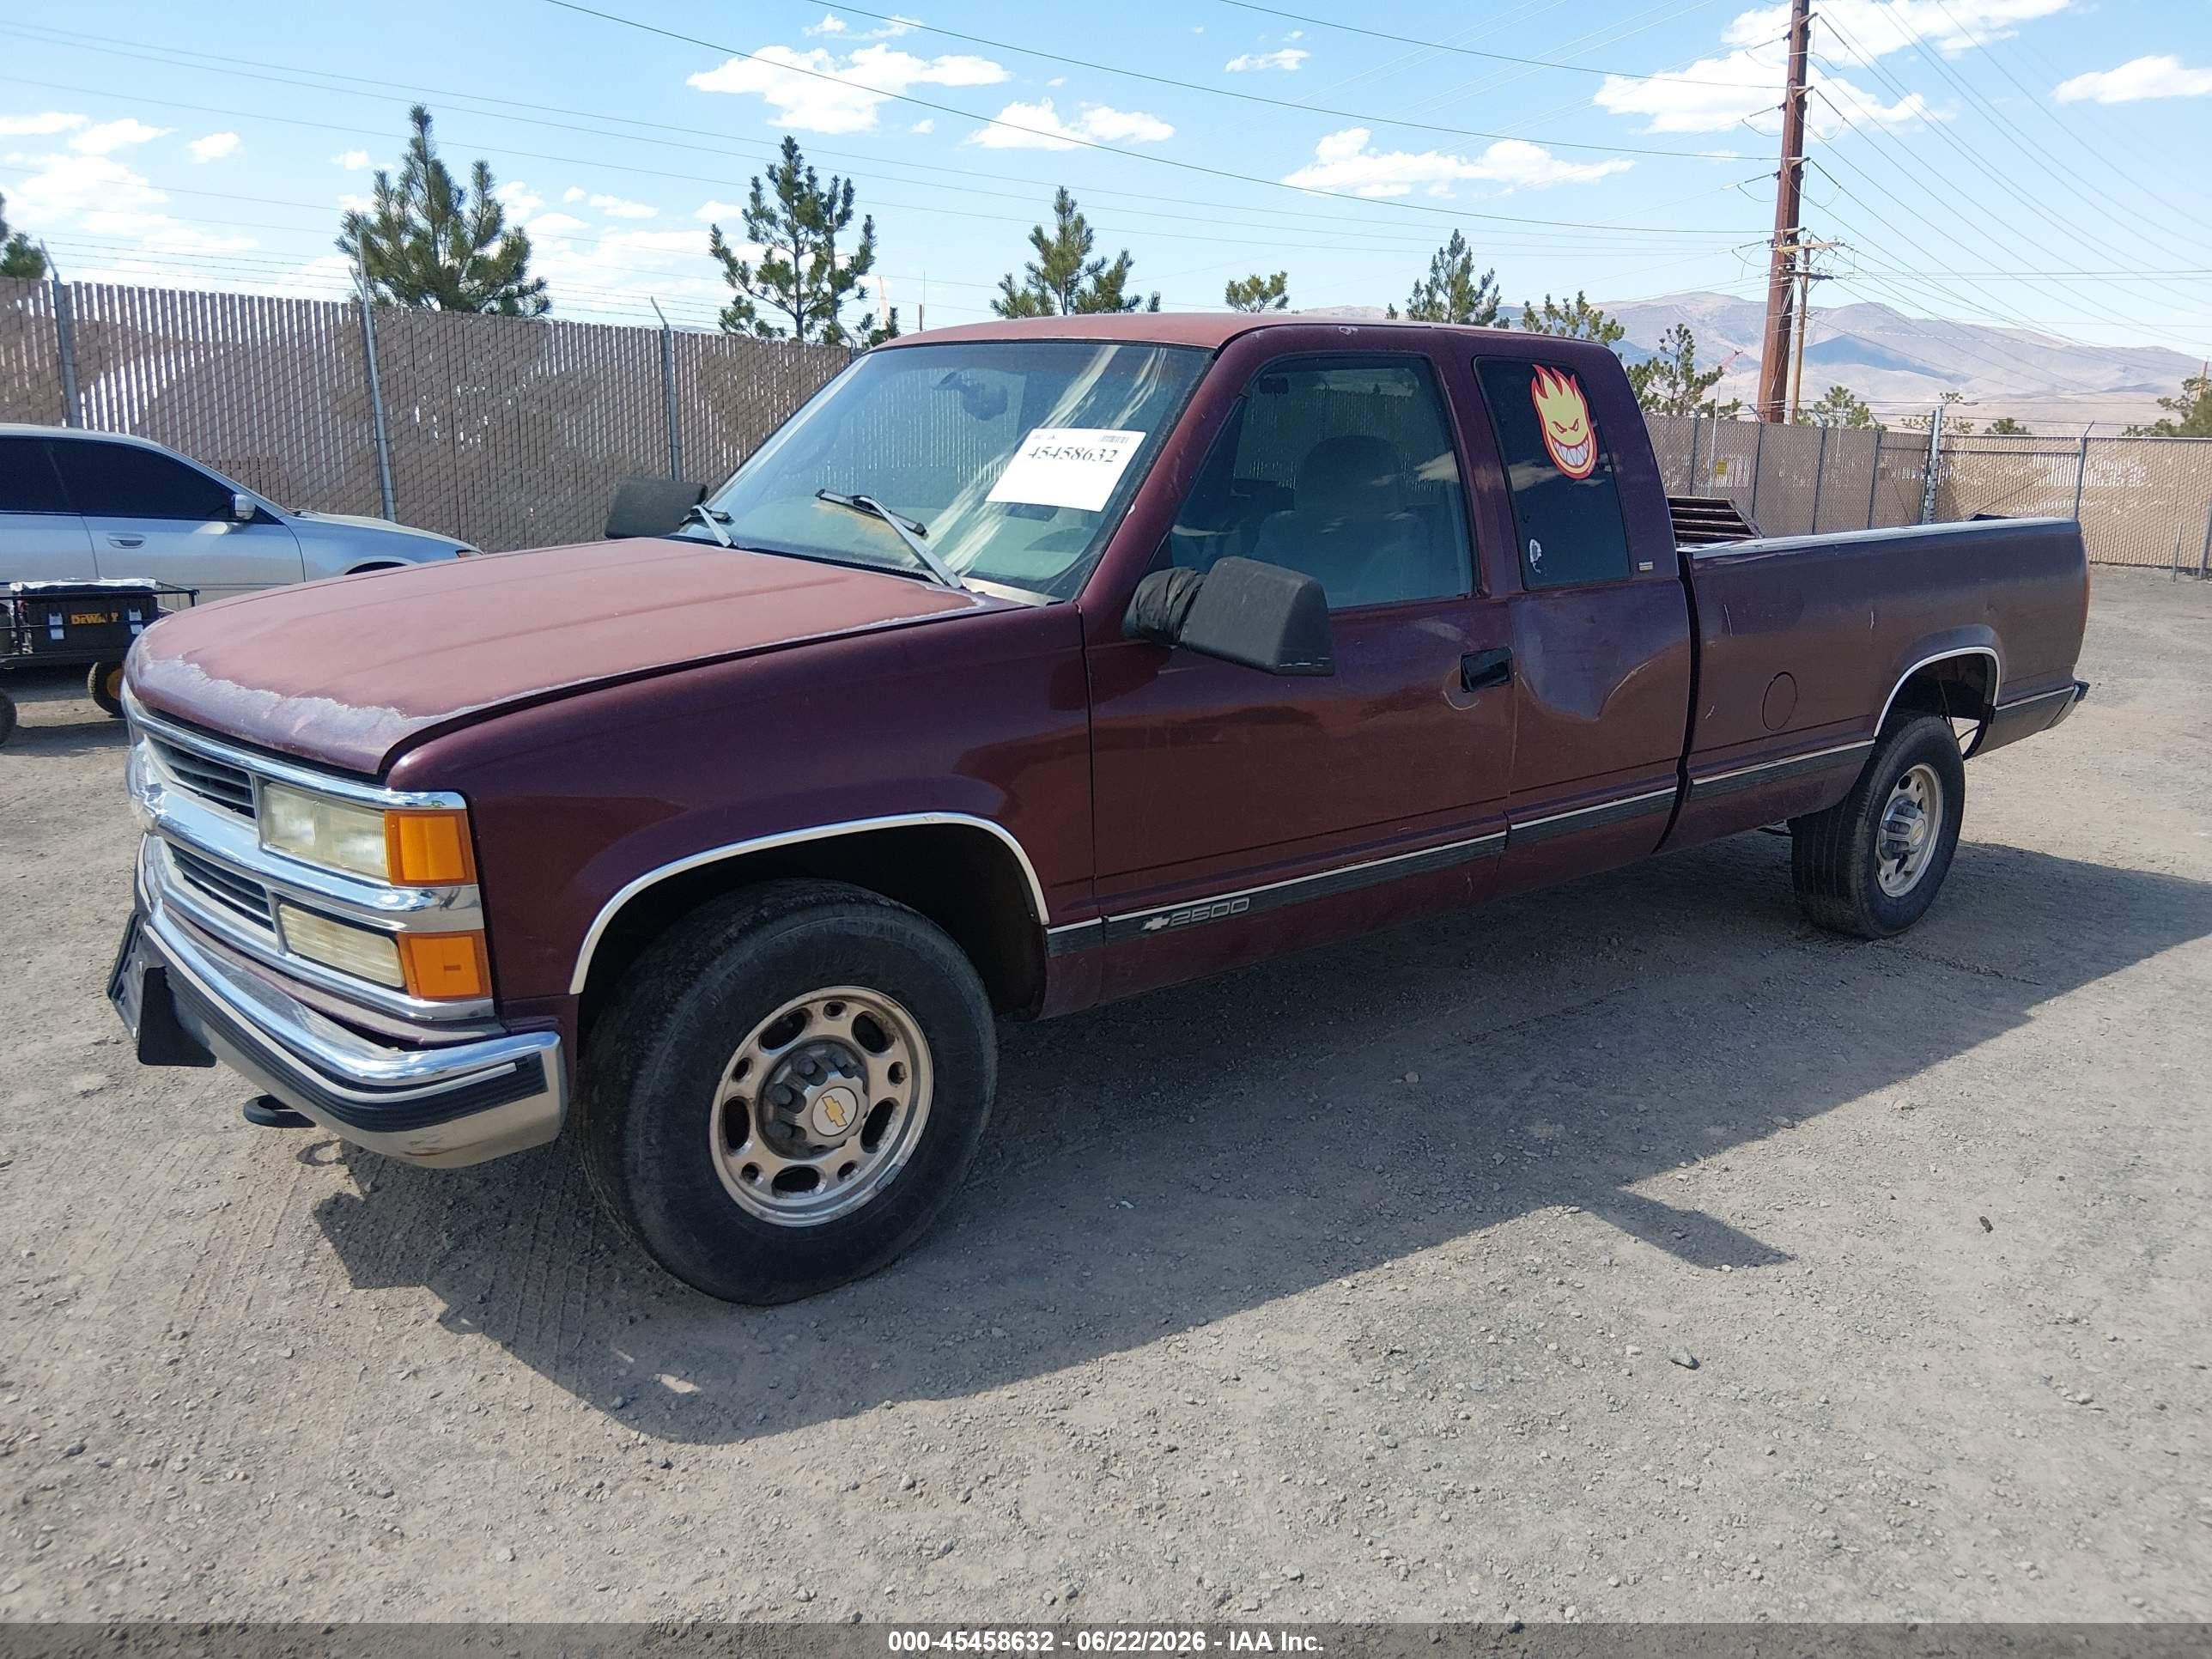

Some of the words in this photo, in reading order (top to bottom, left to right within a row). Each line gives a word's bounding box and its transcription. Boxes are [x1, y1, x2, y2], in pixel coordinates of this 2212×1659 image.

[1028, 447, 1119, 463] 45458632
[71, 611, 118, 624] DEWAT
[1169, 896, 1250, 927] 2500
